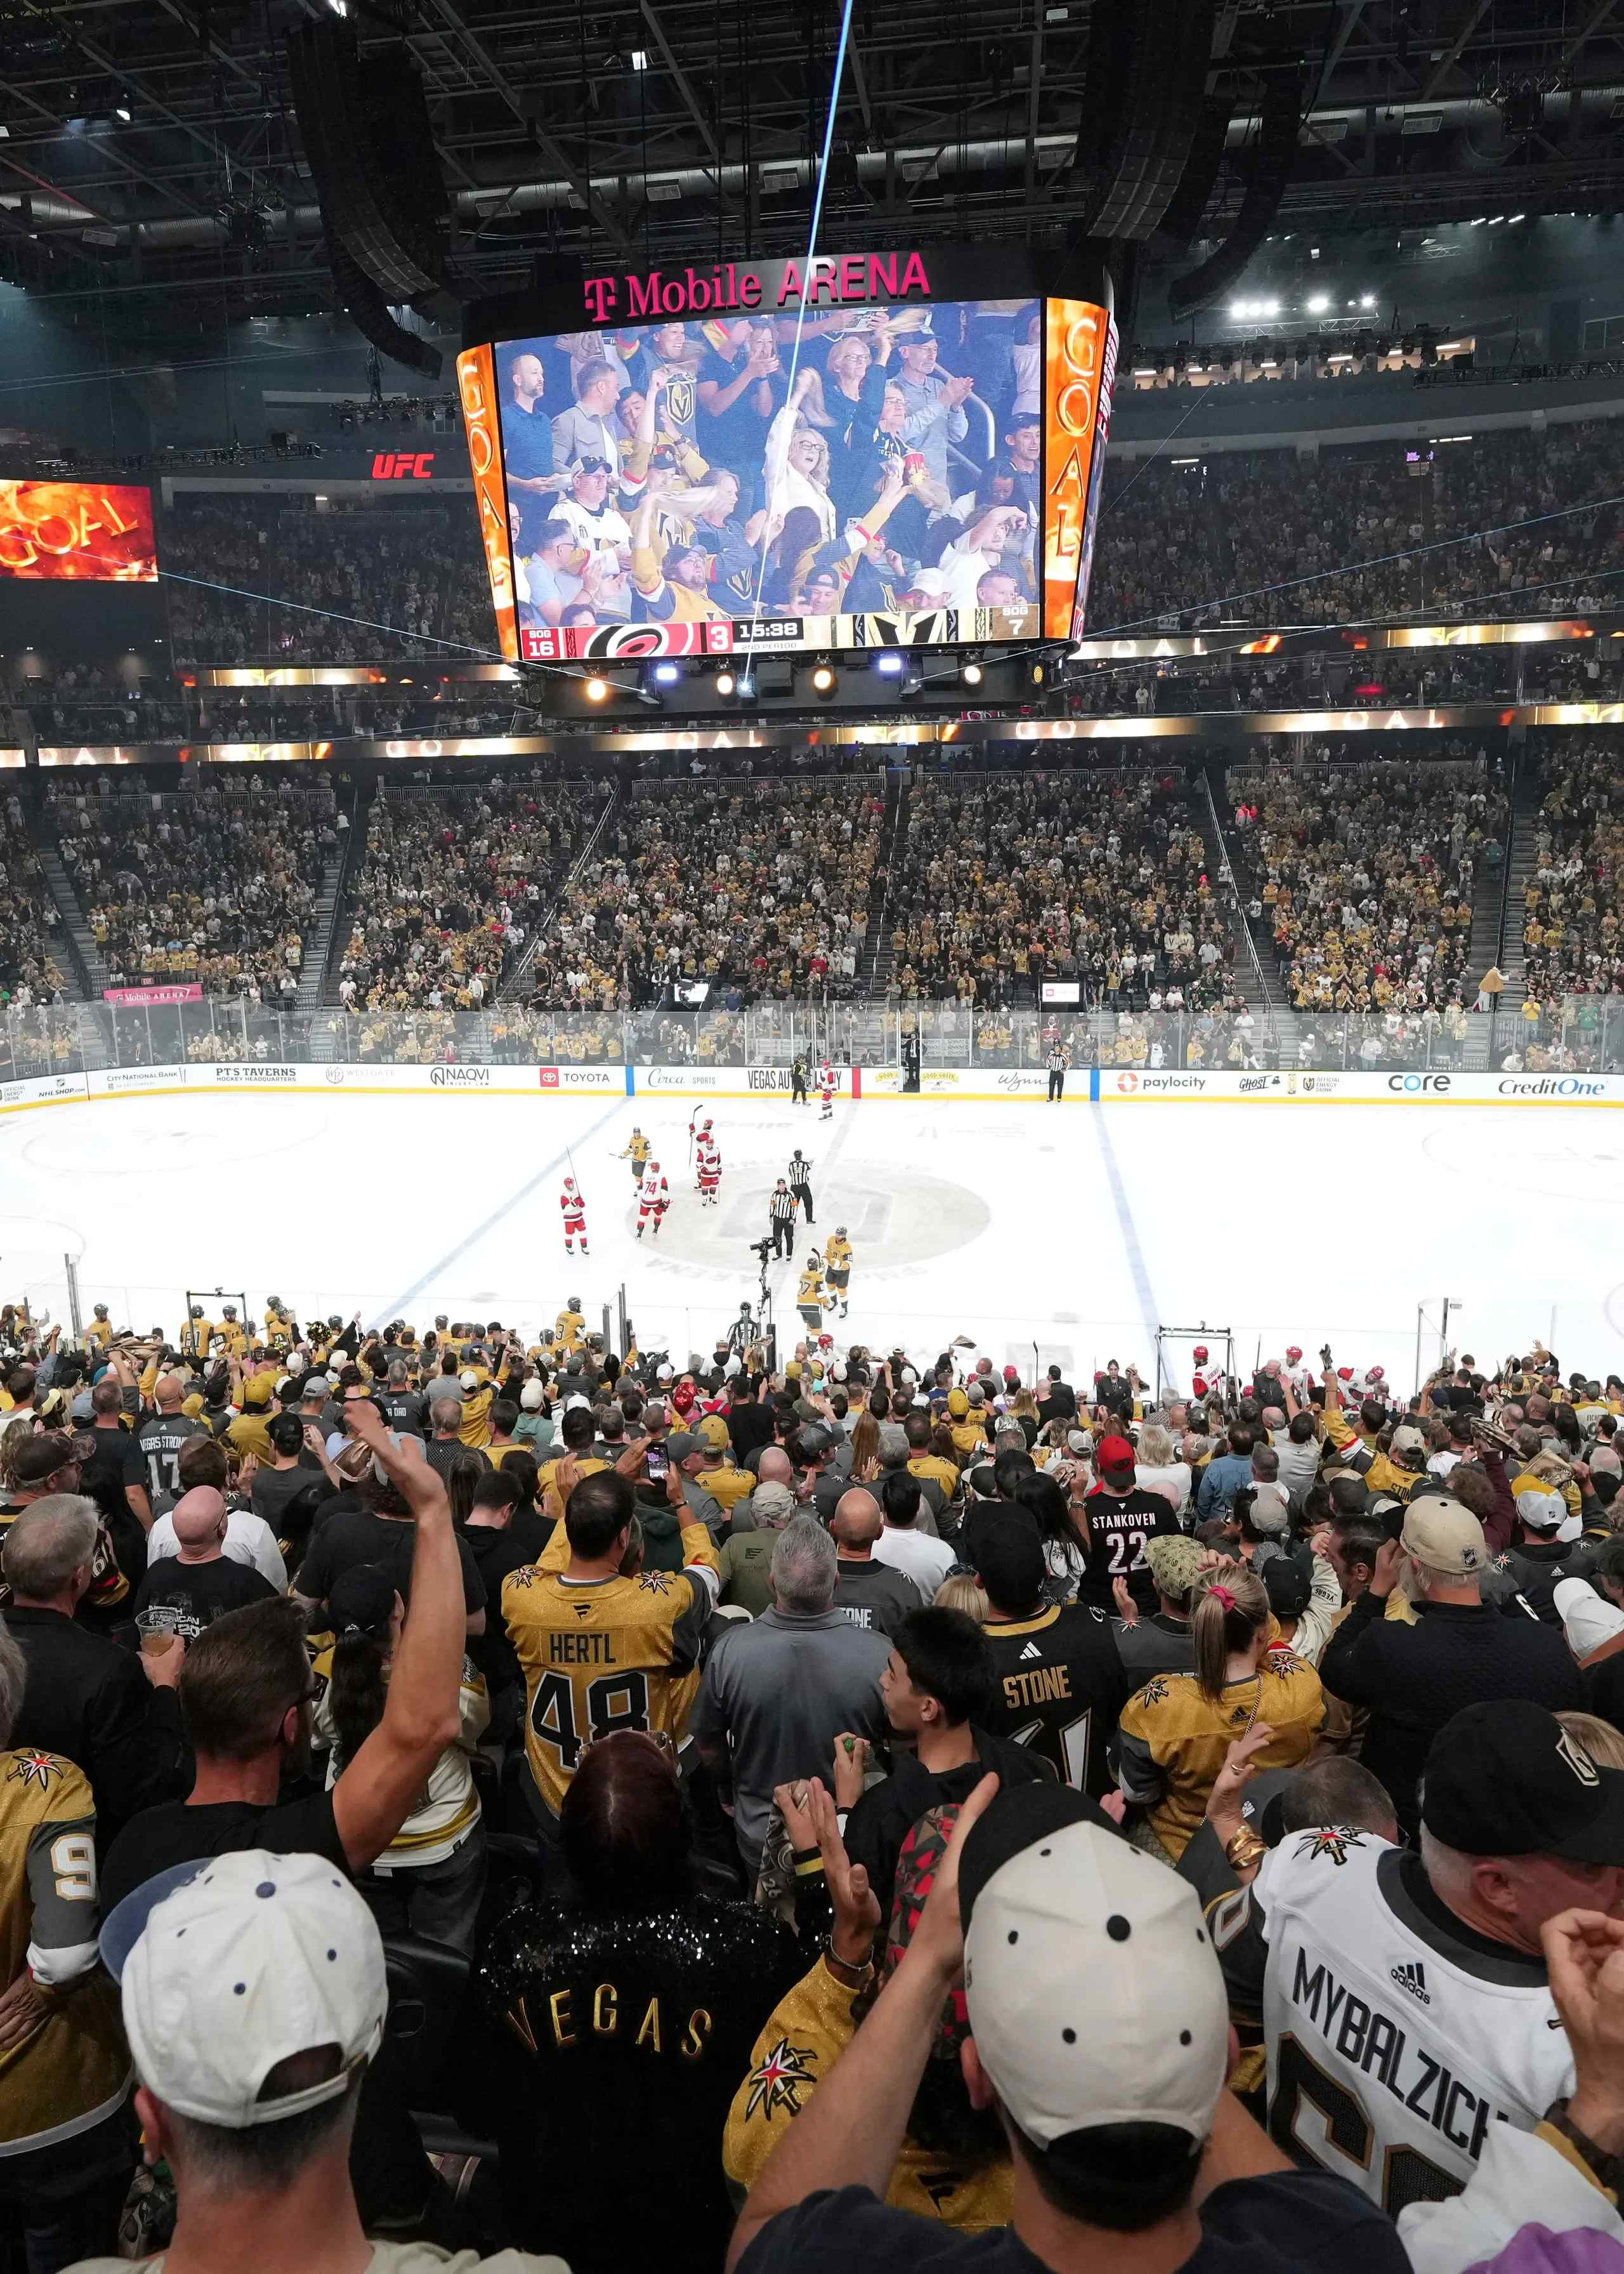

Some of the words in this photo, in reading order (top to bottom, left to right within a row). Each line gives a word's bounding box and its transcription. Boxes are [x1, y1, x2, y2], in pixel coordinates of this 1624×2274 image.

[625, 264, 762, 317] Mobile
[776, 252, 931, 306] ARENA
[1049, 317, 1097, 557] GOAL
[372, 453, 435, 479] UFC
[0, 498, 140, 568] GOAL
[1002, 606, 1028, 616] SOG
[529, 629, 551, 639] SOG
[740, 622, 797, 640] 15:38
[1008, 619, 1024, 635] 7
[710, 624, 730, 650] 3
[763, 642, 797, 650] PERIOD
[529, 641, 554, 657] 16
[125, 993, 151, 1002] Mobile
[216, 1068, 240, 1076] PT'S
[242, 1068, 296, 1076] TAVERNS
[446, 1068, 489, 1081] NAQVI
[563, 1073, 610, 1082] TOYOTA
[648, 1068, 685, 1088] Circa
[747, 1070, 776, 1089] VEGAS
[778, 1070, 793, 1089] AU
[998, 1072, 1050, 1092] Wynn
[1143, 1075, 1206, 1090] paylocity
[1239, 1075, 1271, 1089] GHOST
[1388, 1074, 1451, 1091] core
[645, 1181, 657, 1195] 74
[140, 1436, 162, 1452] VEGAS
[162, 1435, 188, 1449] STRON
[147, 1453, 180, 1497] 17
[1390, 1483, 1411, 1502] STON
[1092, 1512, 1156, 1529] STANKOVEN
[1106, 1530, 1149, 1574] 22
[549, 1633, 617, 1664] HERTL
[1002, 1664, 1072, 1709] STONE
[532, 1670, 650, 1772] 48
[50, 1832, 97, 1902] 9
[1390, 1968, 1432, 2006] adidas
[508, 1983, 712, 2056] VEGAS
